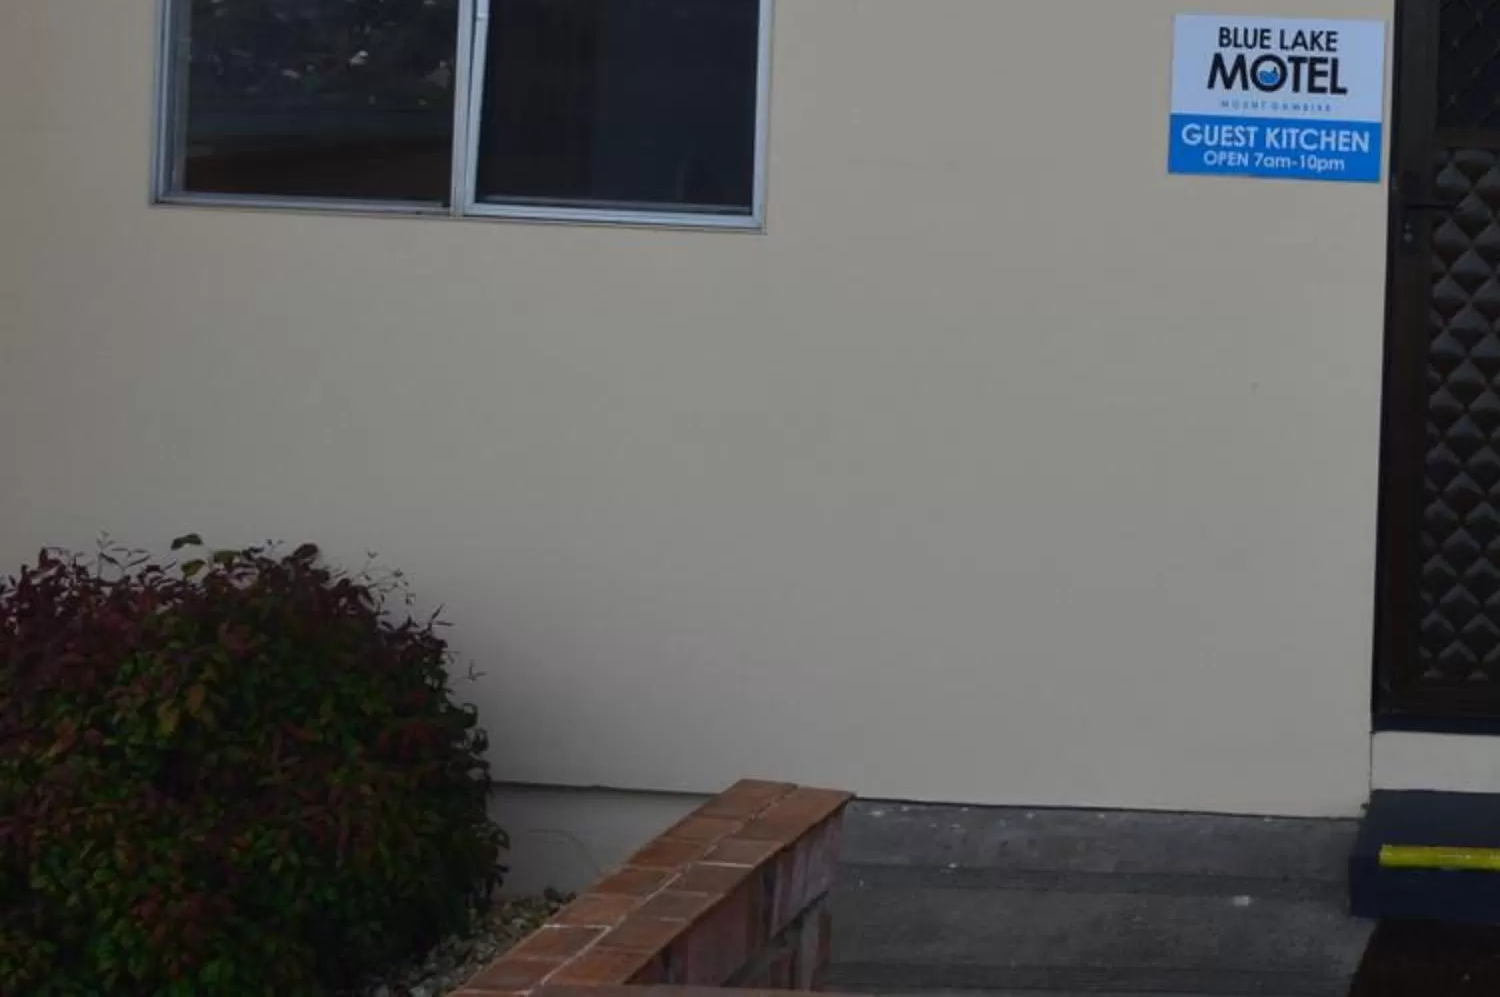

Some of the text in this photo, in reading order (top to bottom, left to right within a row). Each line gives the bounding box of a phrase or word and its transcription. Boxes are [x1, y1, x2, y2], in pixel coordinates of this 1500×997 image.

[1218, 26, 1339, 52] BLUE LAKE
[1207, 52, 1348, 95] MOTEL
[1181, 122, 1370, 153] GUEST KITCHEN
[1203, 150, 1345, 172] OPEN 7am-10pm
